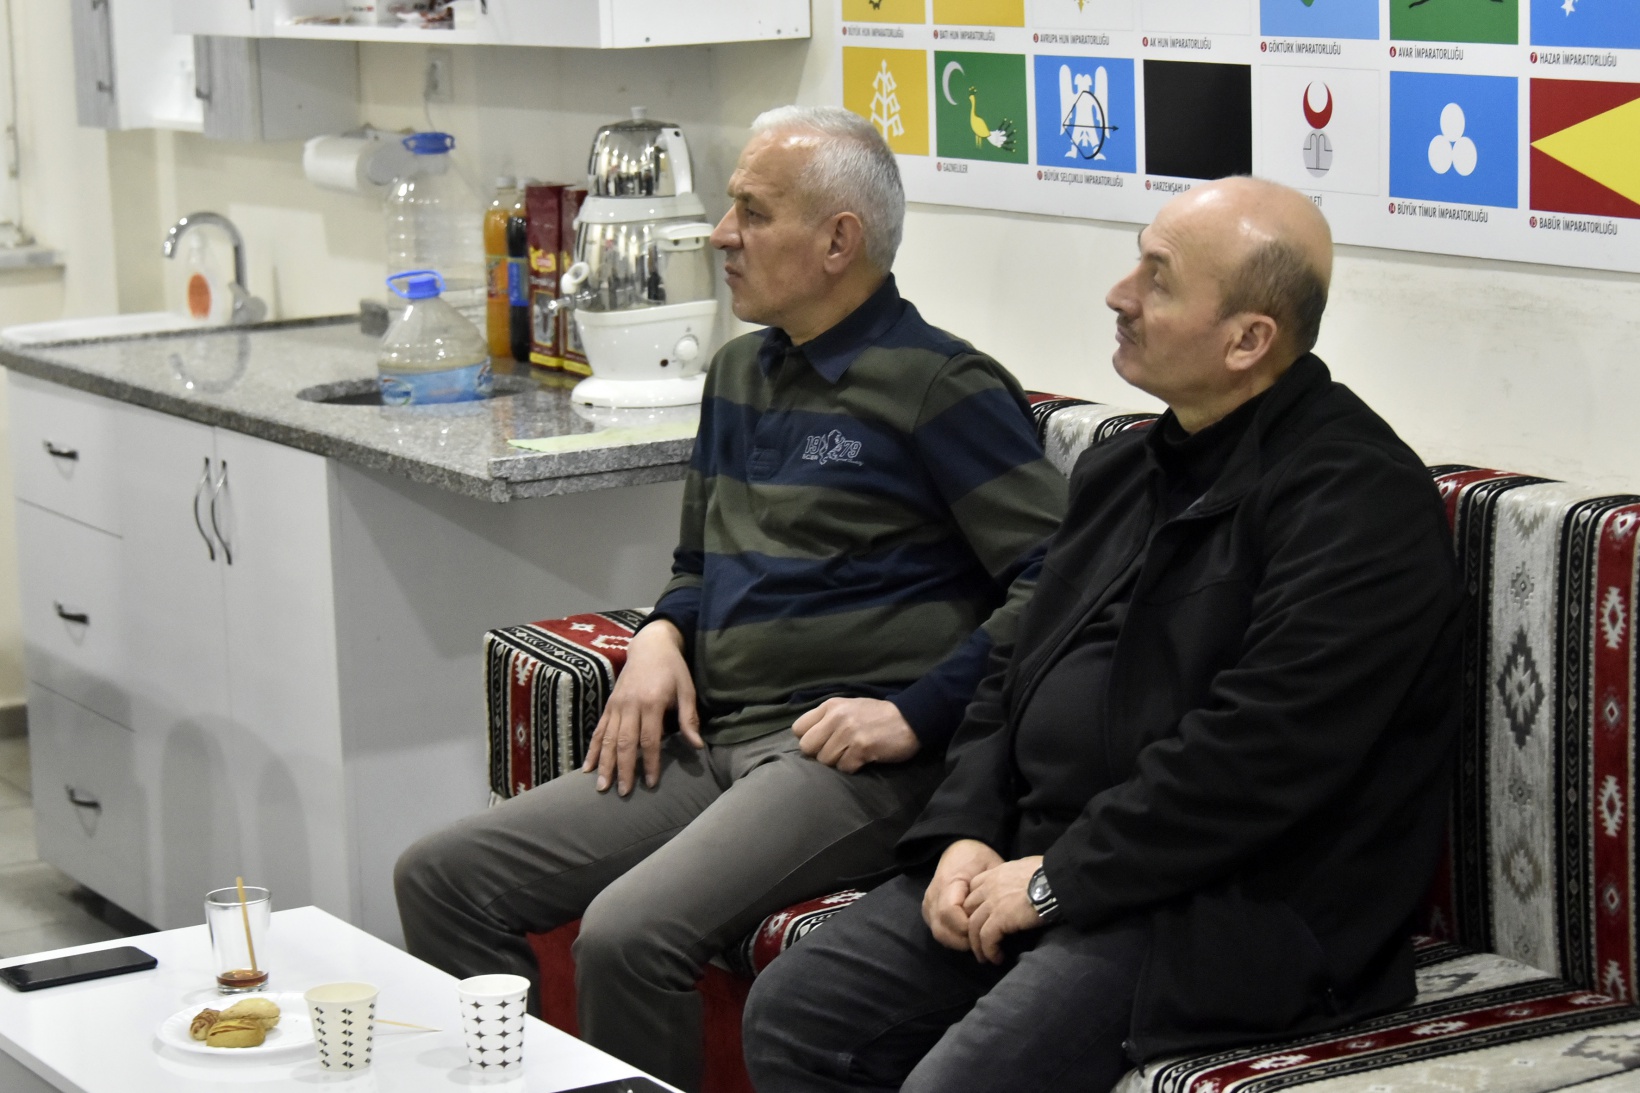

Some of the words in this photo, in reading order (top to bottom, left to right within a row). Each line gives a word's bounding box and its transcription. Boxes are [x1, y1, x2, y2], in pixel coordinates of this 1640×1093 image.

[1059, 34, 1070, 44] HUN
[1150, 38, 1157, 47] AK
[1158, 39, 1168, 48] HUN
[1269, 40, 1294, 53] GÖKTÜRK
[1295, 41, 1341, 55] İMPARATORLUĞU
[1398, 47, 1413, 58] AVAR
[1415, 45, 1464, 60] İMPARATORLUĞU
[1540, 52, 1560, 65] HAZAR
[1562, 51, 1617, 67] İMPARATORLUĞU
[1397, 201, 1417, 216] BÜYÜK
[1418, 203, 1437, 218] TİMUR
[1438, 205, 1488, 223] İMPARATORLUĞU
[1539, 216, 1560, 230] BABÜR
[1562, 217, 1617, 235] İMPARATORLUĞU
